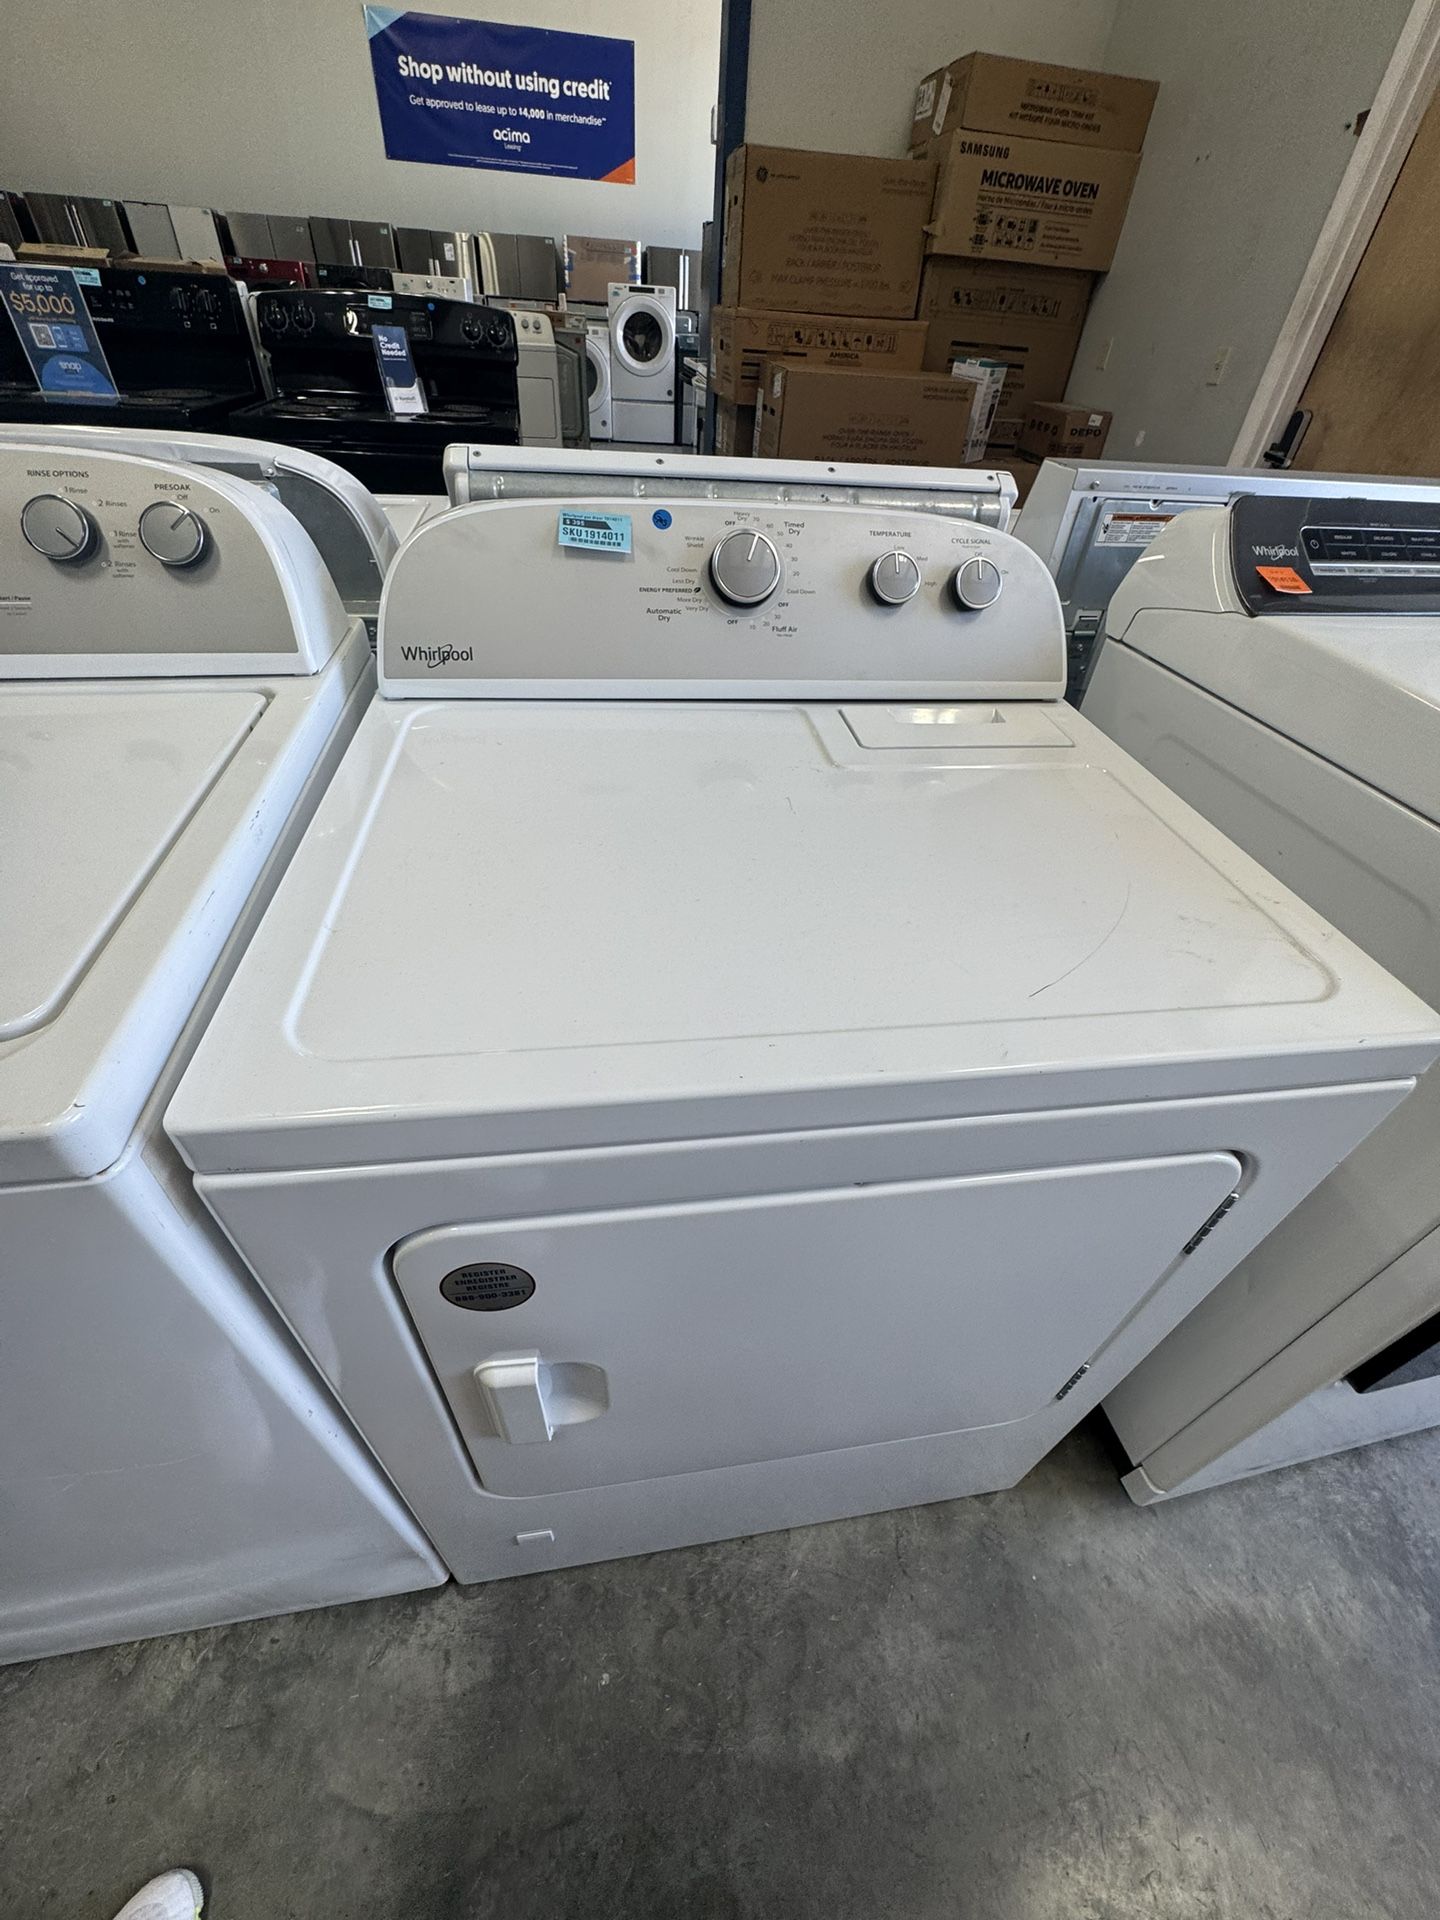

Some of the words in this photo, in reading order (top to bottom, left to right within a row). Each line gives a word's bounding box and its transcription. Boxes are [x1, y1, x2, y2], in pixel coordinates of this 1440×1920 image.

[398, 55, 443, 84] Shop
[447, 64, 512, 90] without
[516, 72, 560, 99] using
[409, 94, 424, 106] Get
[425, 96, 464, 112] approved
[466, 100, 474, 112] to
[475, 101, 496, 114] lease
[497, 106, 508, 117] up
[508, 106, 517, 116] to
[518, 107, 545, 120] $4,000
[546, 110, 554, 120] in
[493, 128, 530, 144] acima
[960, 141, 1010, 160] SAMSUNG
[980, 169, 1060, 196] MICROWAVE
[1062, 179, 1100, 200] OVEN
[10, 272, 24, 281] Get
[24, 273, 58, 284] approved
[22, 282, 34, 290] for
[34, 284, 45, 292] up
[46, 284, 54, 292] to
[10, 290, 75, 316] $5,000
[378, 334, 388, 342] No
[380, 341, 400, 350] Credit
[380, 349, 407, 357] Needed
[27, 470, 50, 478] RINSE
[52, 470, 90, 478] OPTIONS
[64, 486, 68, 494] 1
[154, 484, 191, 492] PRESOAK
[98, 500, 104, 508] 2
[105, 500, 128, 508] Rinses
[209, 506, 221, 514] On
[114, 530, 118, 538] 1
[118, 530, 138, 538] Rinse
[562, 527, 582, 538] SKU
[584, 530, 624, 542] 1914011
[788, 528, 801, 536] Dry
[870, 530, 912, 538] TEMPERATURE
[1252, 544, 1300, 561] Whirlpool
[684, 578, 696, 586] Dry
[658, 614, 671, 622] Dry
[400, 644, 474, 668] Whirlpool
[462, 1268, 506, 1278] REGISTER
[454, 1274, 518, 1286] ENREGISTRER
[466, 1282, 510, 1292] REGISTRE
